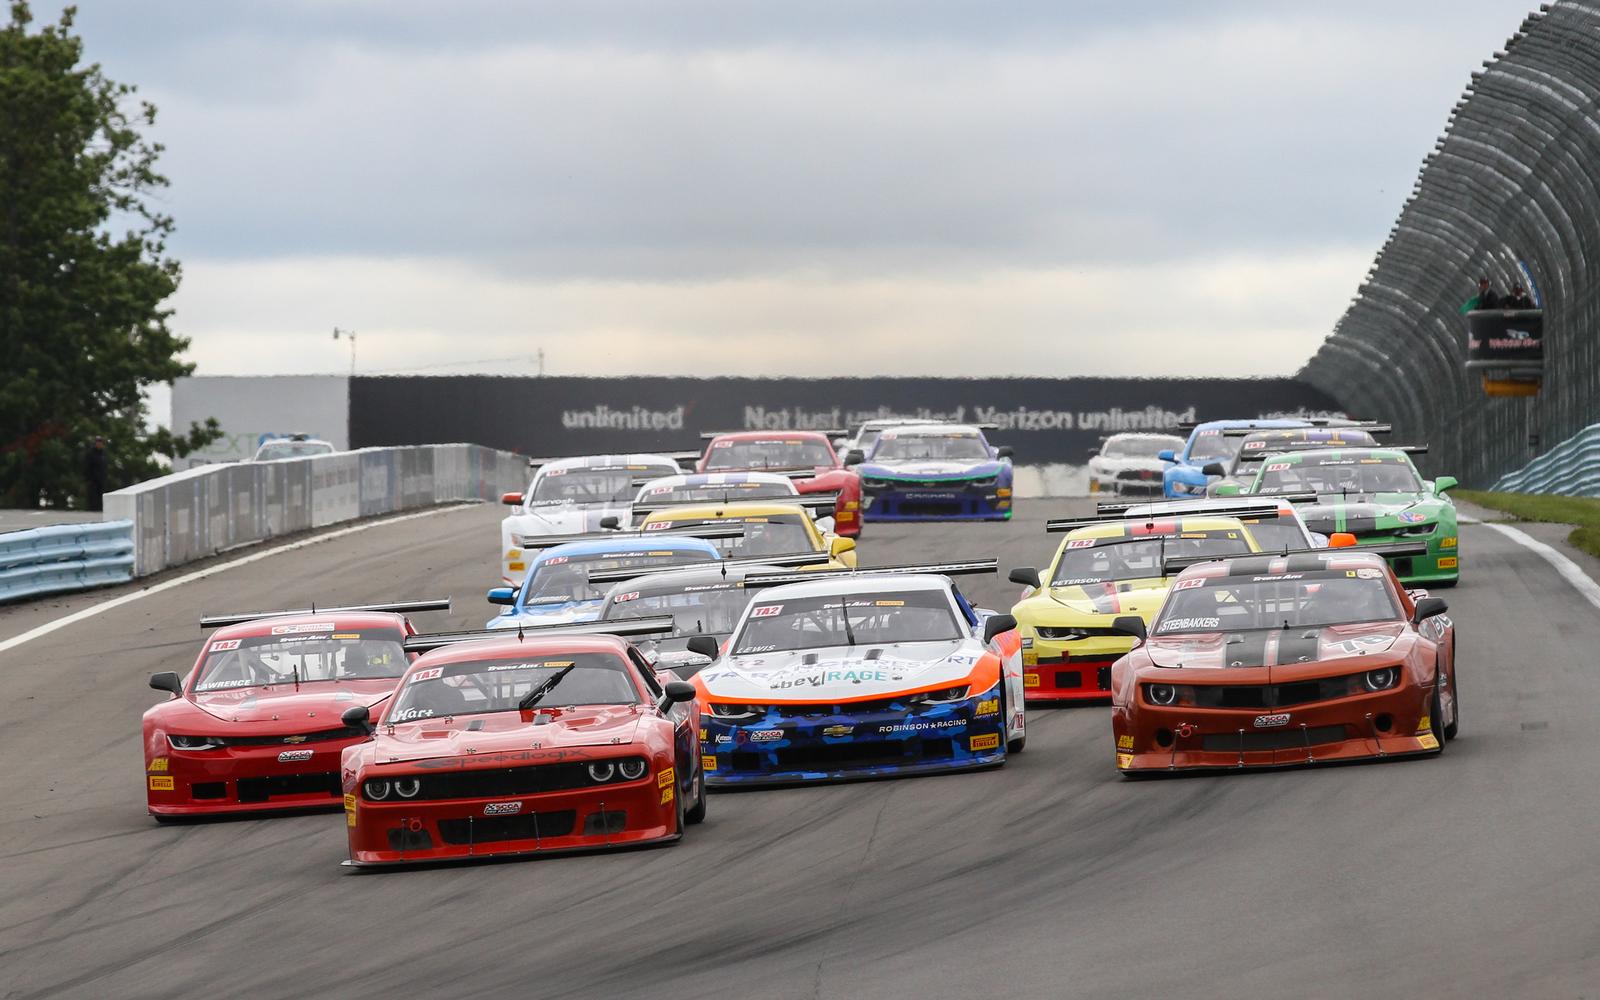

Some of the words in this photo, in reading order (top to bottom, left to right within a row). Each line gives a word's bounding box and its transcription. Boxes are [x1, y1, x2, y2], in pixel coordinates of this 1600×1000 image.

[562, 405, 684, 429] unlimited
[745, 406, 790, 429] Not
[795, 406, 840, 430] just
[975, 406, 1073, 430] Verizon
[1078, 405, 1196, 431] unlimited
[1051, 578, 1101, 586] PETERSON
[1177, 579, 1201, 589] TA2
[756, 606, 779, 616] TA2
[1161, 618, 1220, 632] STEENBAKKERS
[214, 641, 238, 650] TA2
[736, 645, 776, 654] LEWIS
[415, 670, 440, 680] TA2
[196, 680, 251, 691] LAWRENCE
[879, 723, 929, 732] ROBINSON
[937, 719, 967, 728] RACING
